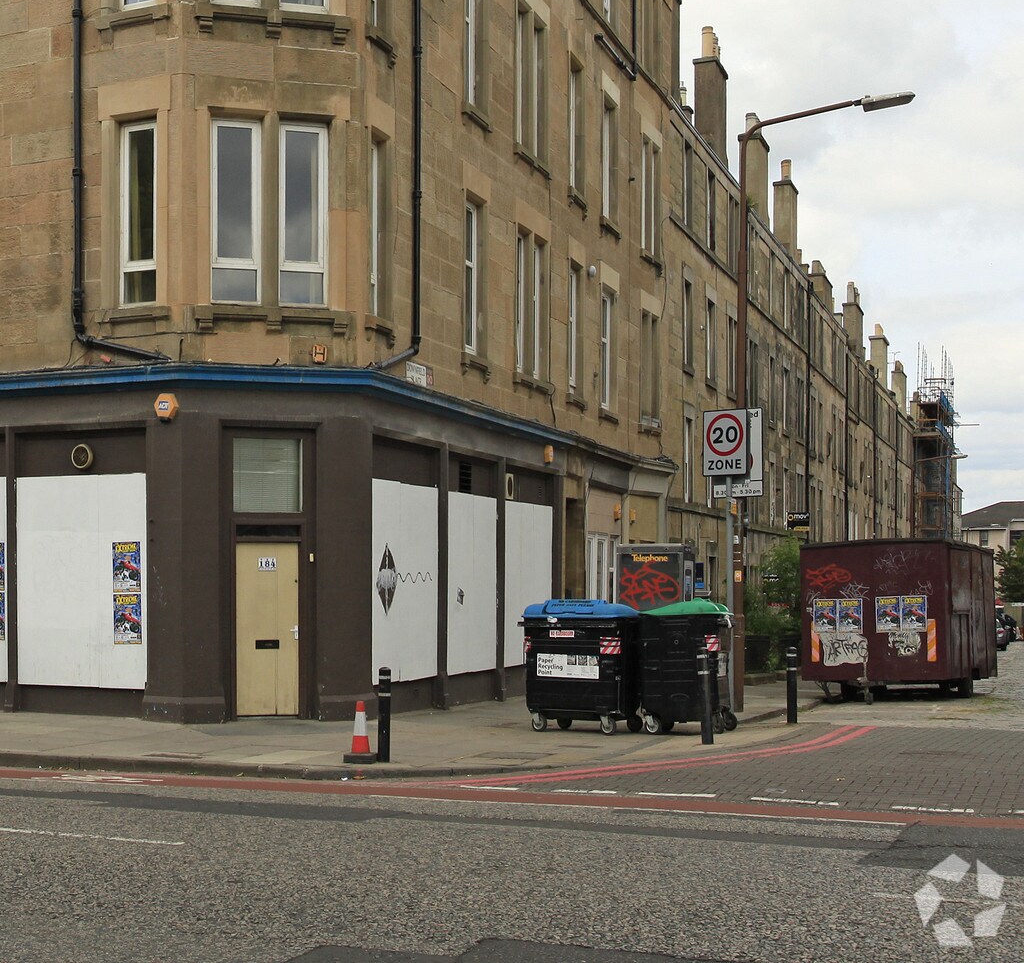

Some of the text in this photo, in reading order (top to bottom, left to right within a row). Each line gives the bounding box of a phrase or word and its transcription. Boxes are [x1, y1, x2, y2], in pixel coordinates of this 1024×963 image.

[712, 426, 738, 444] 20
[708, 458, 742, 470] ZONE
[632, 554, 668, 563] Telephone
[538, 663, 563, 671] Recycling
